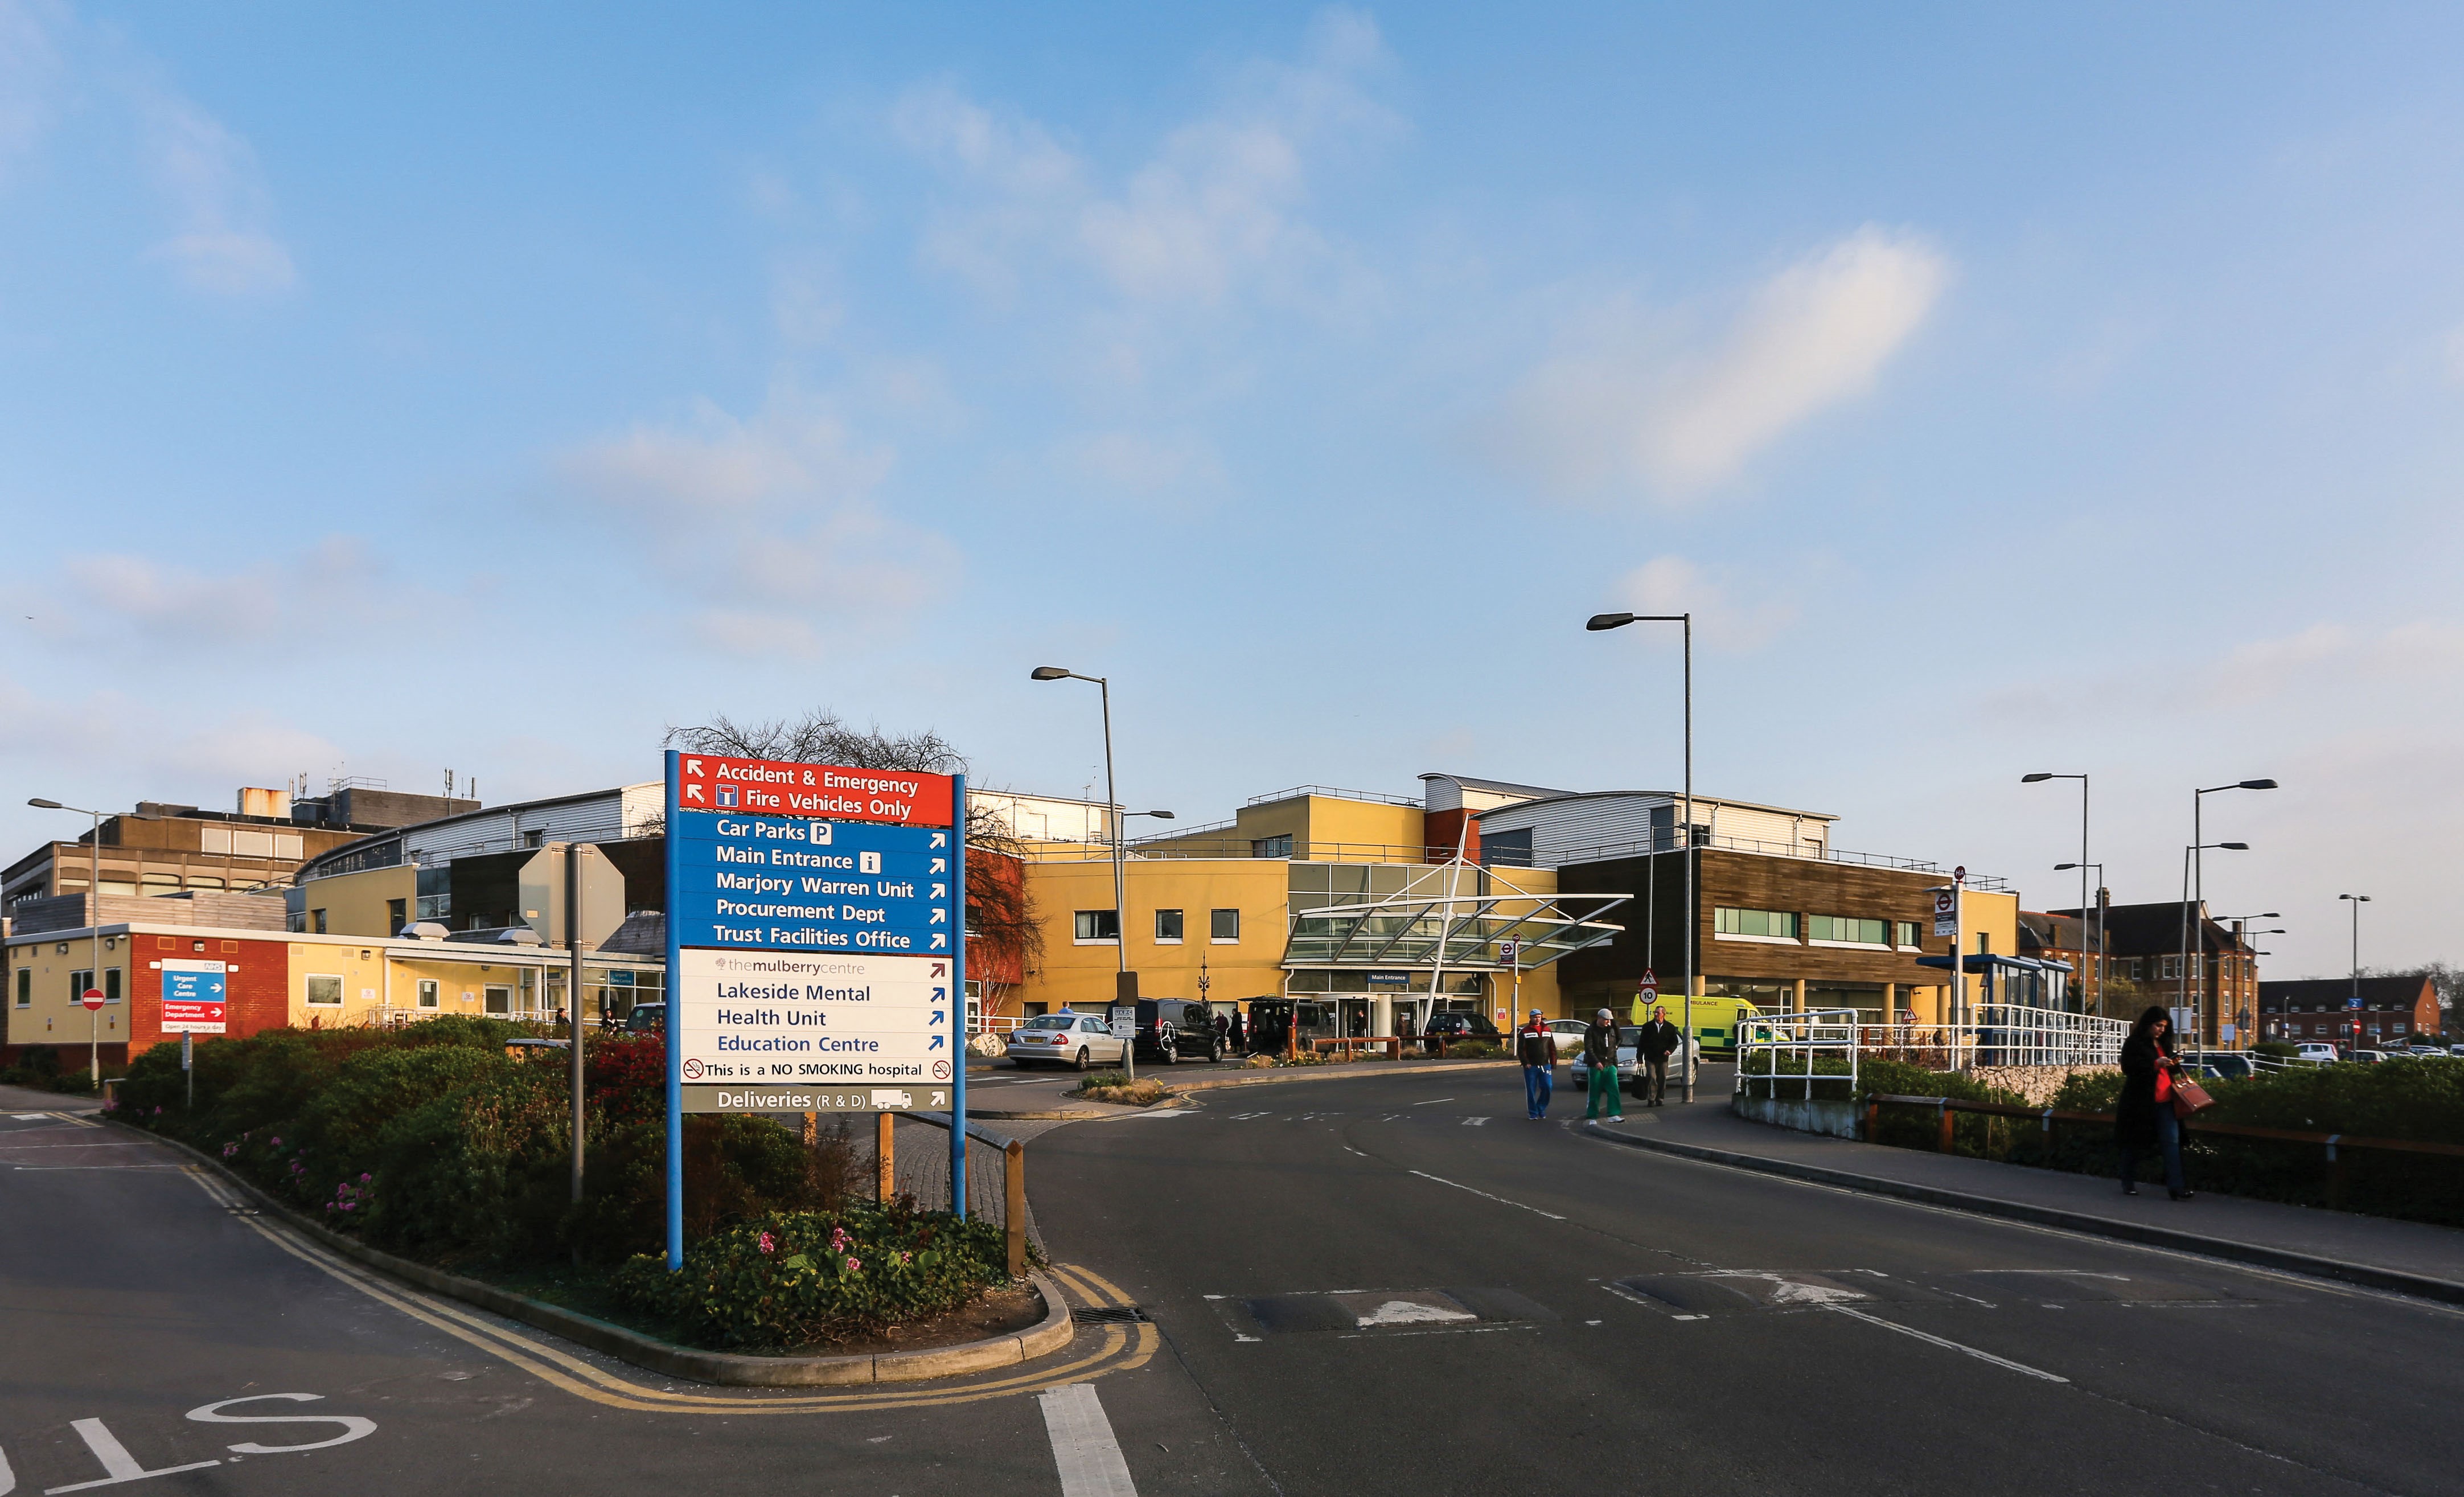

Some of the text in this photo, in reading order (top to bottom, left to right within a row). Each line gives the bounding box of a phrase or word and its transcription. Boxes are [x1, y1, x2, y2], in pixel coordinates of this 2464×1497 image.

[716, 763, 918, 797] Accident & Emergency
[746, 789, 911, 820] Fire Vehicles Only
[717, 819, 828, 842] Car Parks P
[716, 845, 765, 864] Main
[771, 849, 853, 869] Entrance
[716, 872, 914, 898] Marjory Warren Unit
[717, 899, 885, 924] Procurement Dept
[713, 925, 910, 949] Trust Facilities Office
[729, 958, 865, 976] themulberrycentre
[717, 983, 870, 1002] Lakeside Mental
[717, 1009, 827, 1026] Health Unit
[718, 1035, 879, 1052] Education Centre
[705, 1063, 922, 1078] This is a NO SMOKING hospital
[717, 1090, 866, 1110] Deliveries (R & D)
